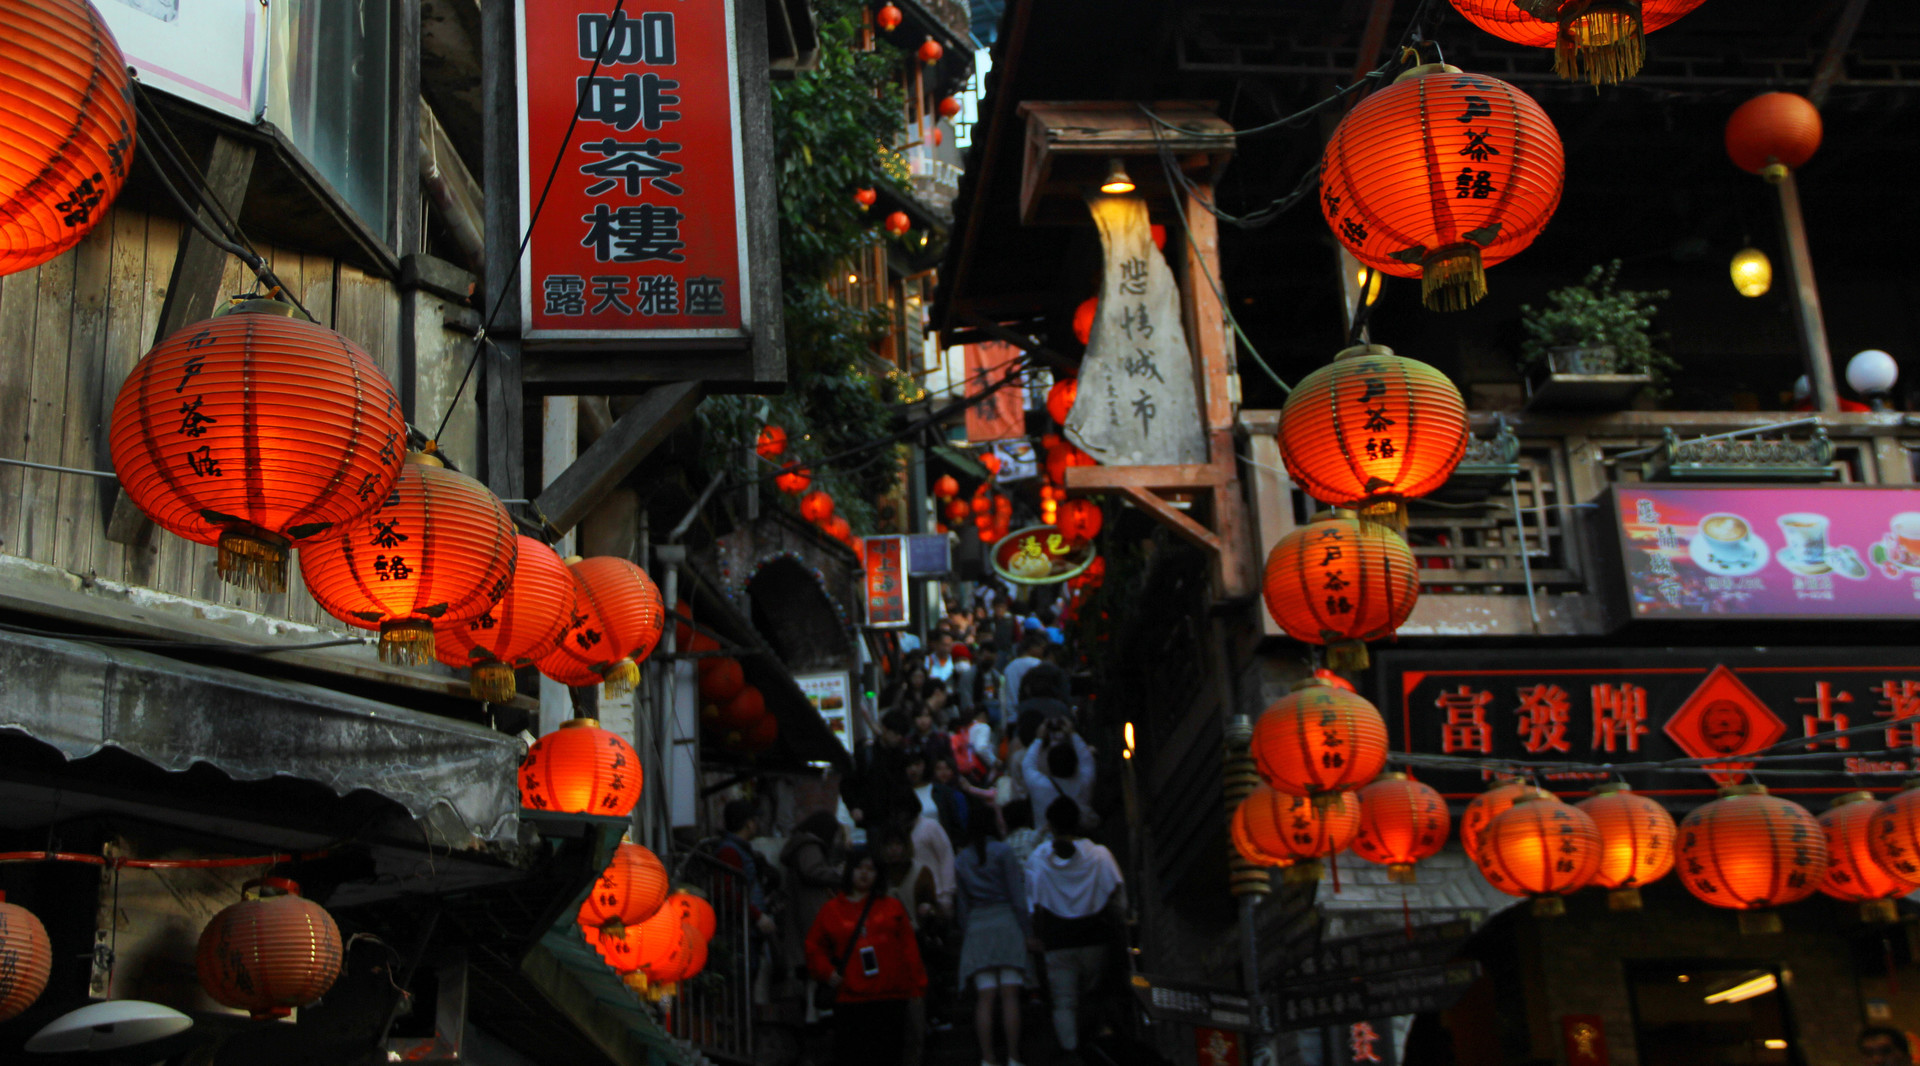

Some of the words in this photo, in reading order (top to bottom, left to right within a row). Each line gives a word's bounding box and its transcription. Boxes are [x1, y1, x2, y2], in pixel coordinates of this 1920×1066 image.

[576, 10, 687, 263] 咖啡茶樓
[543, 275, 727, 317] 露天雅座
[1119, 256, 1164, 440] 悲情城市
[1433, 683, 1651, 755] 富發牌
